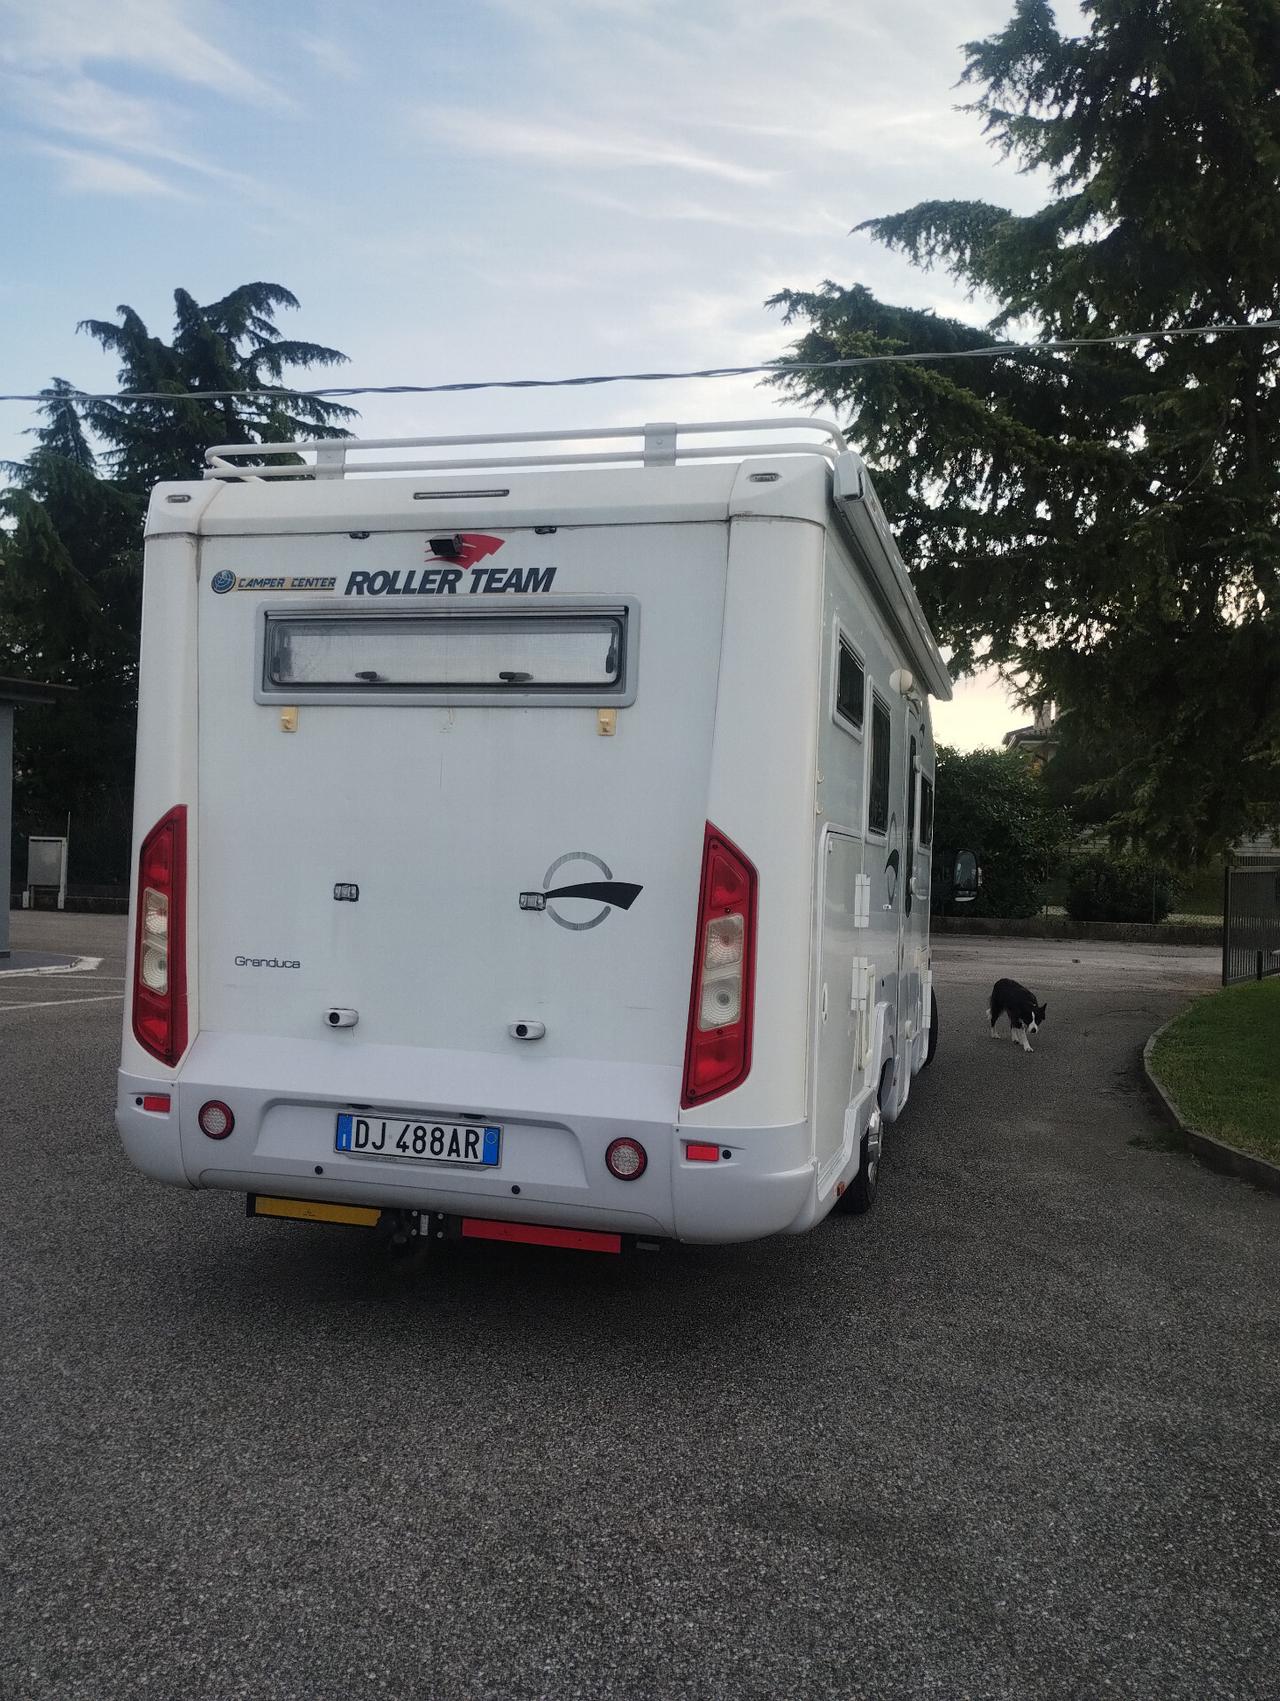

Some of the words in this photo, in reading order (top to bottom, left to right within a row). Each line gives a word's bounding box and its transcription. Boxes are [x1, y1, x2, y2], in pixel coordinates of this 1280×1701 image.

[238, 578, 285, 588] CAMPER
[290, 577, 336, 587] CENTER
[344, 569, 463, 595] ROLLER
[469, 567, 557, 593] TEAM
[234, 955, 301, 969] Granduca
[354, 1119, 387, 1151] DJ
[395, 1123, 481, 1160] 488AR
